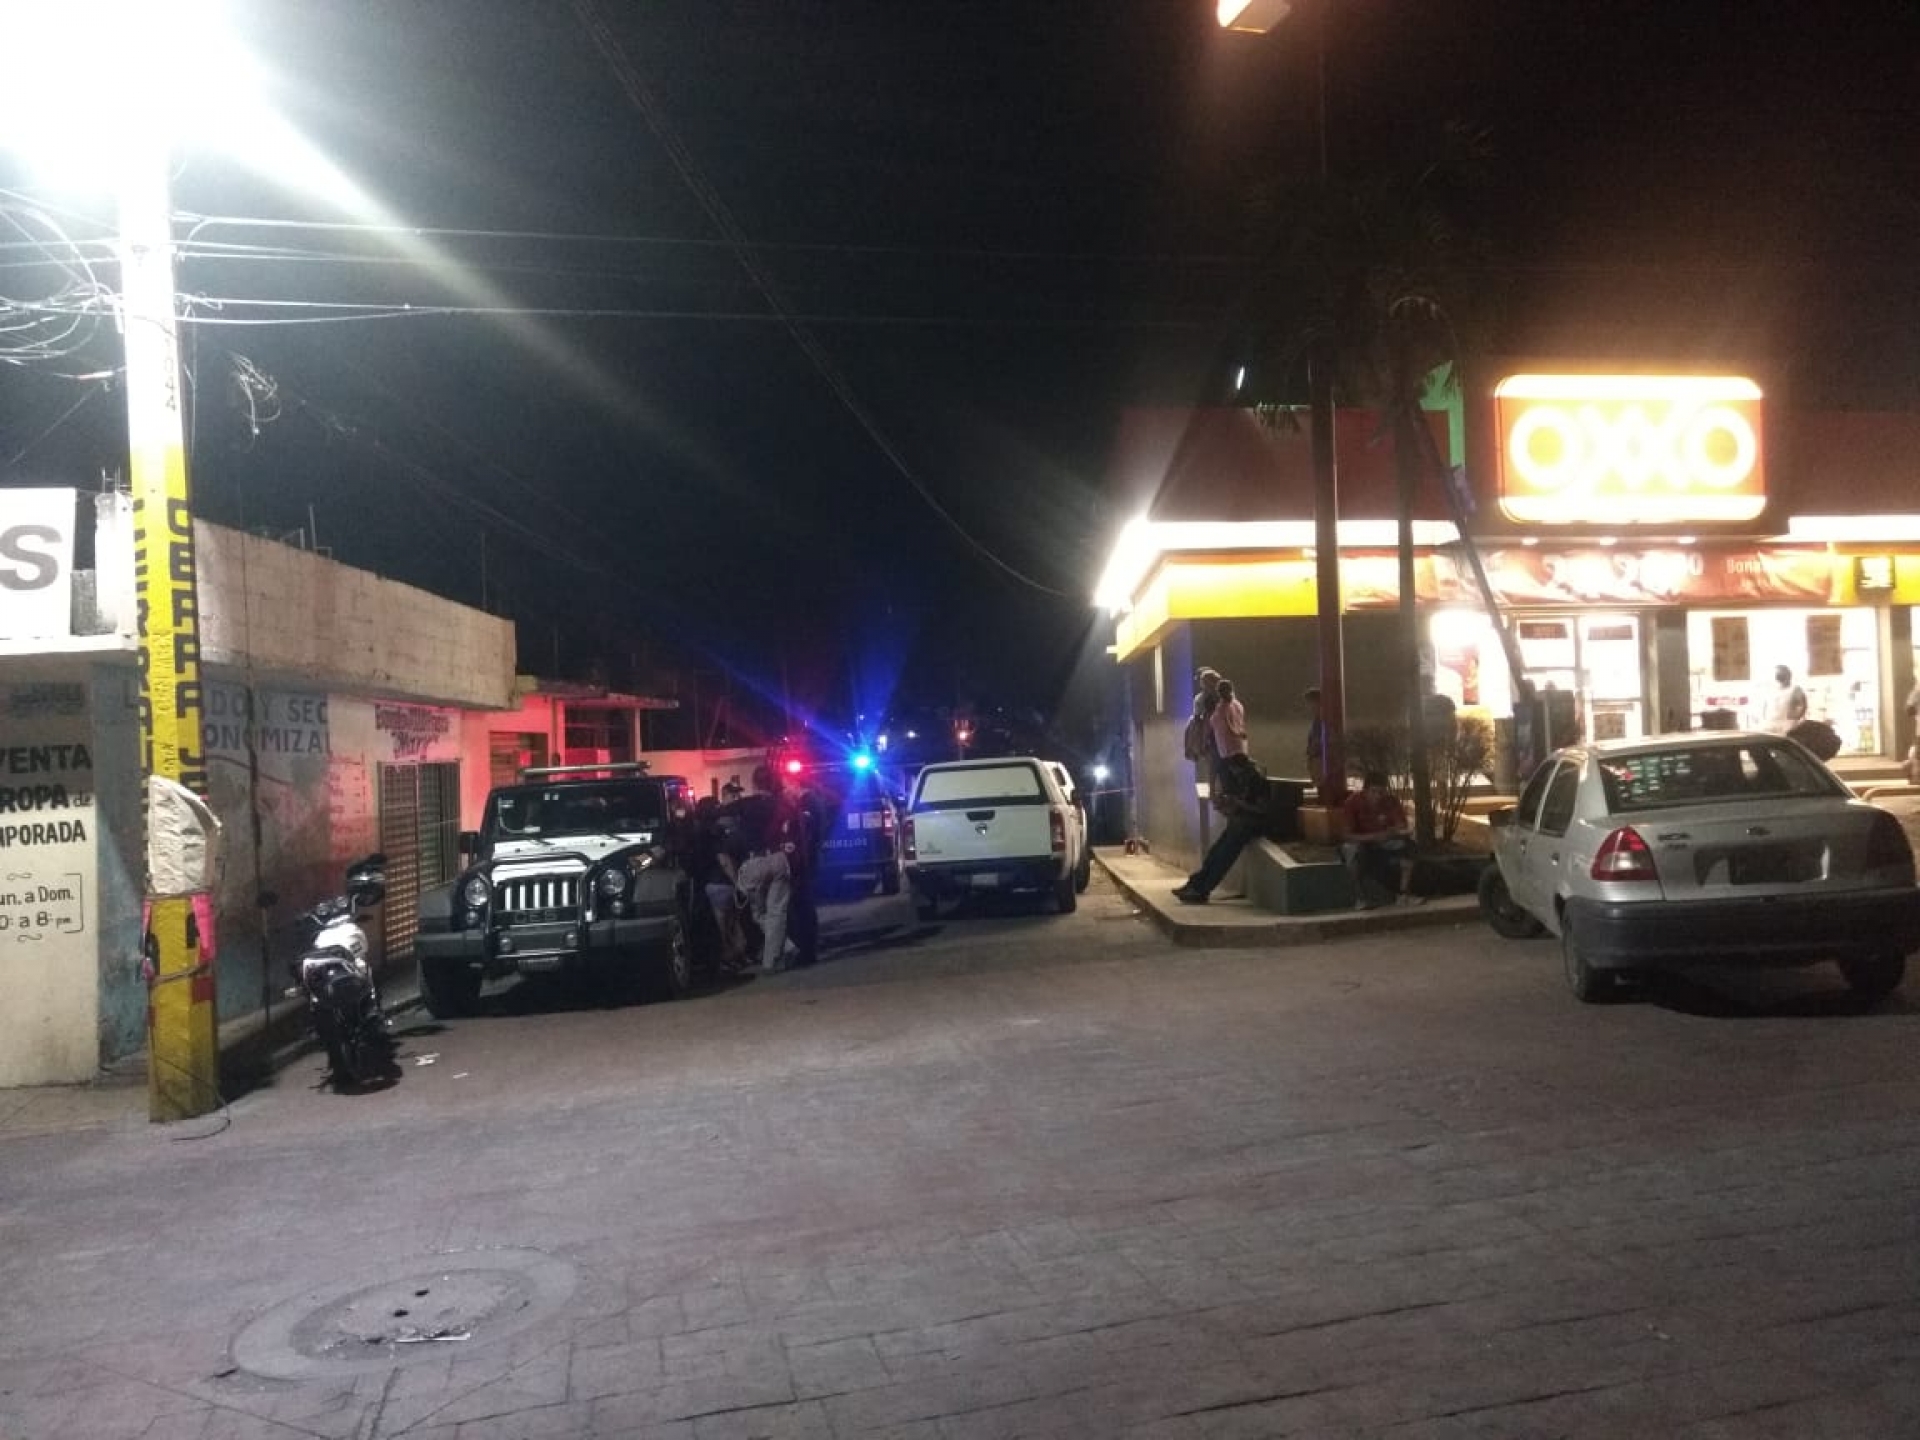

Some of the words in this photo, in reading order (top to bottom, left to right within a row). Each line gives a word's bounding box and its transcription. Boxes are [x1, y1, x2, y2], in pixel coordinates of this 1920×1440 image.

[1509, 402, 1756, 491] OXXO
[203, 723, 324, 753] ONOMIZA
[0, 744, 93, 774] ENTA
[0, 893, 22, 906] un.
[23, 890, 35, 903] a
[38, 886, 74, 902] Dom.
[19, 916, 30, 928] a
